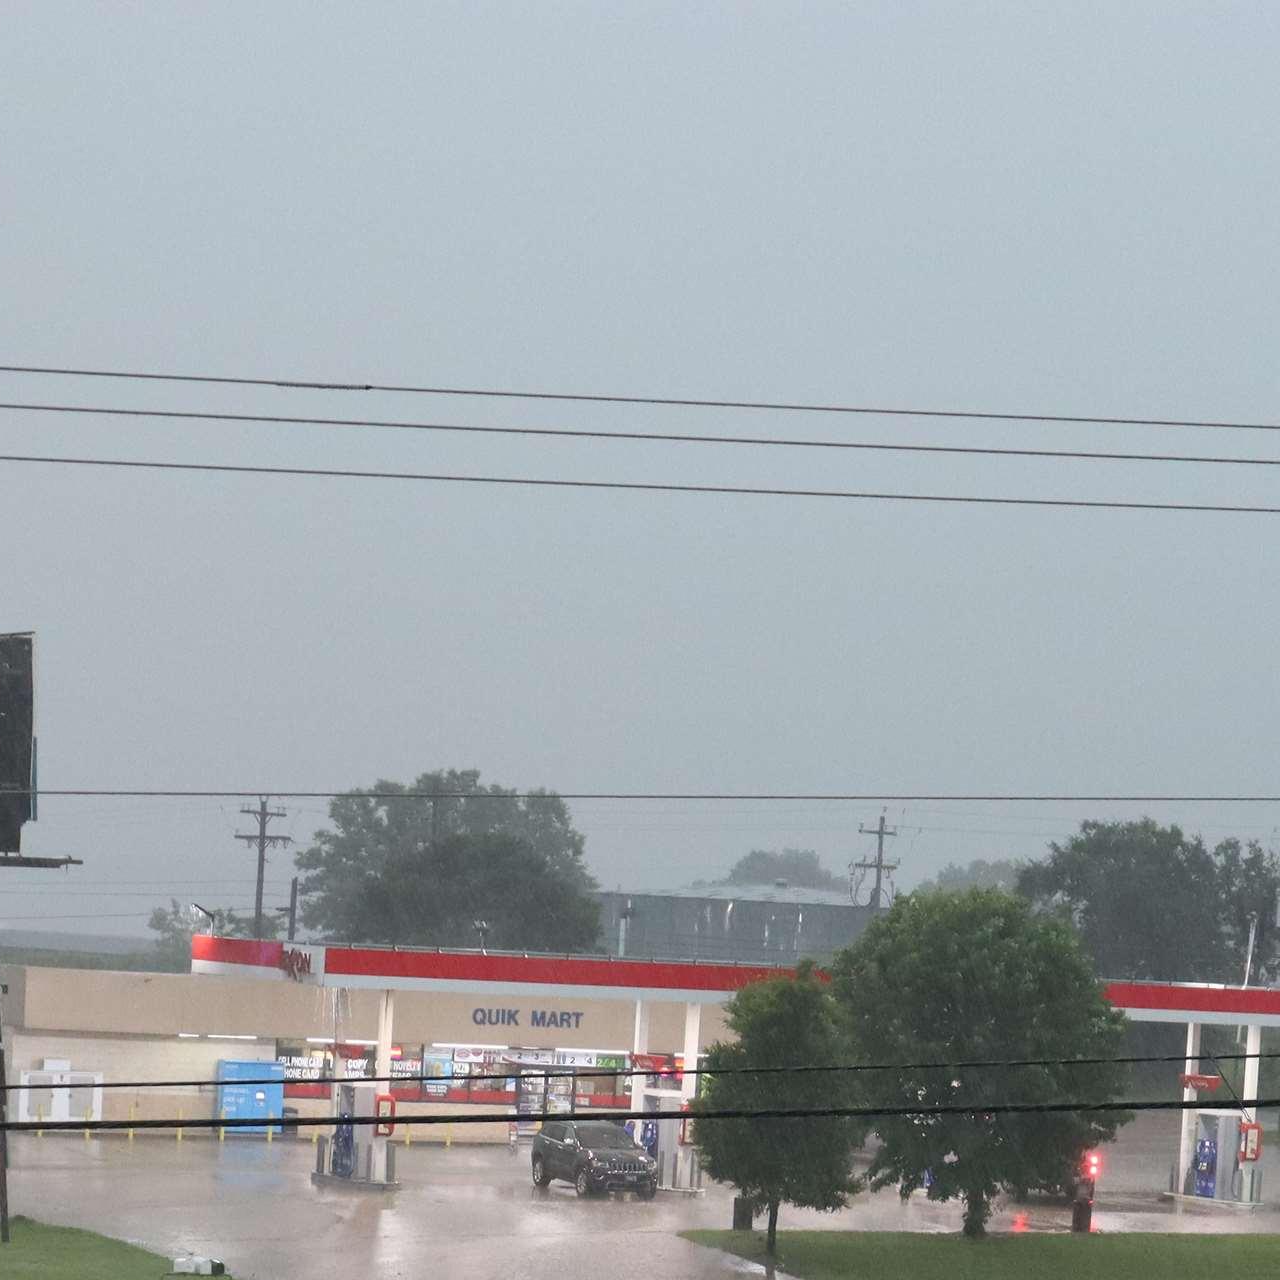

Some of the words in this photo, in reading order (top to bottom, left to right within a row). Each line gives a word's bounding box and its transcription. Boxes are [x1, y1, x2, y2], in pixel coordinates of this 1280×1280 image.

[472, 1007, 520, 1026] QUIK
[531, 1010, 584, 1028] MART
[347, 1059, 368, 1070] COPY
